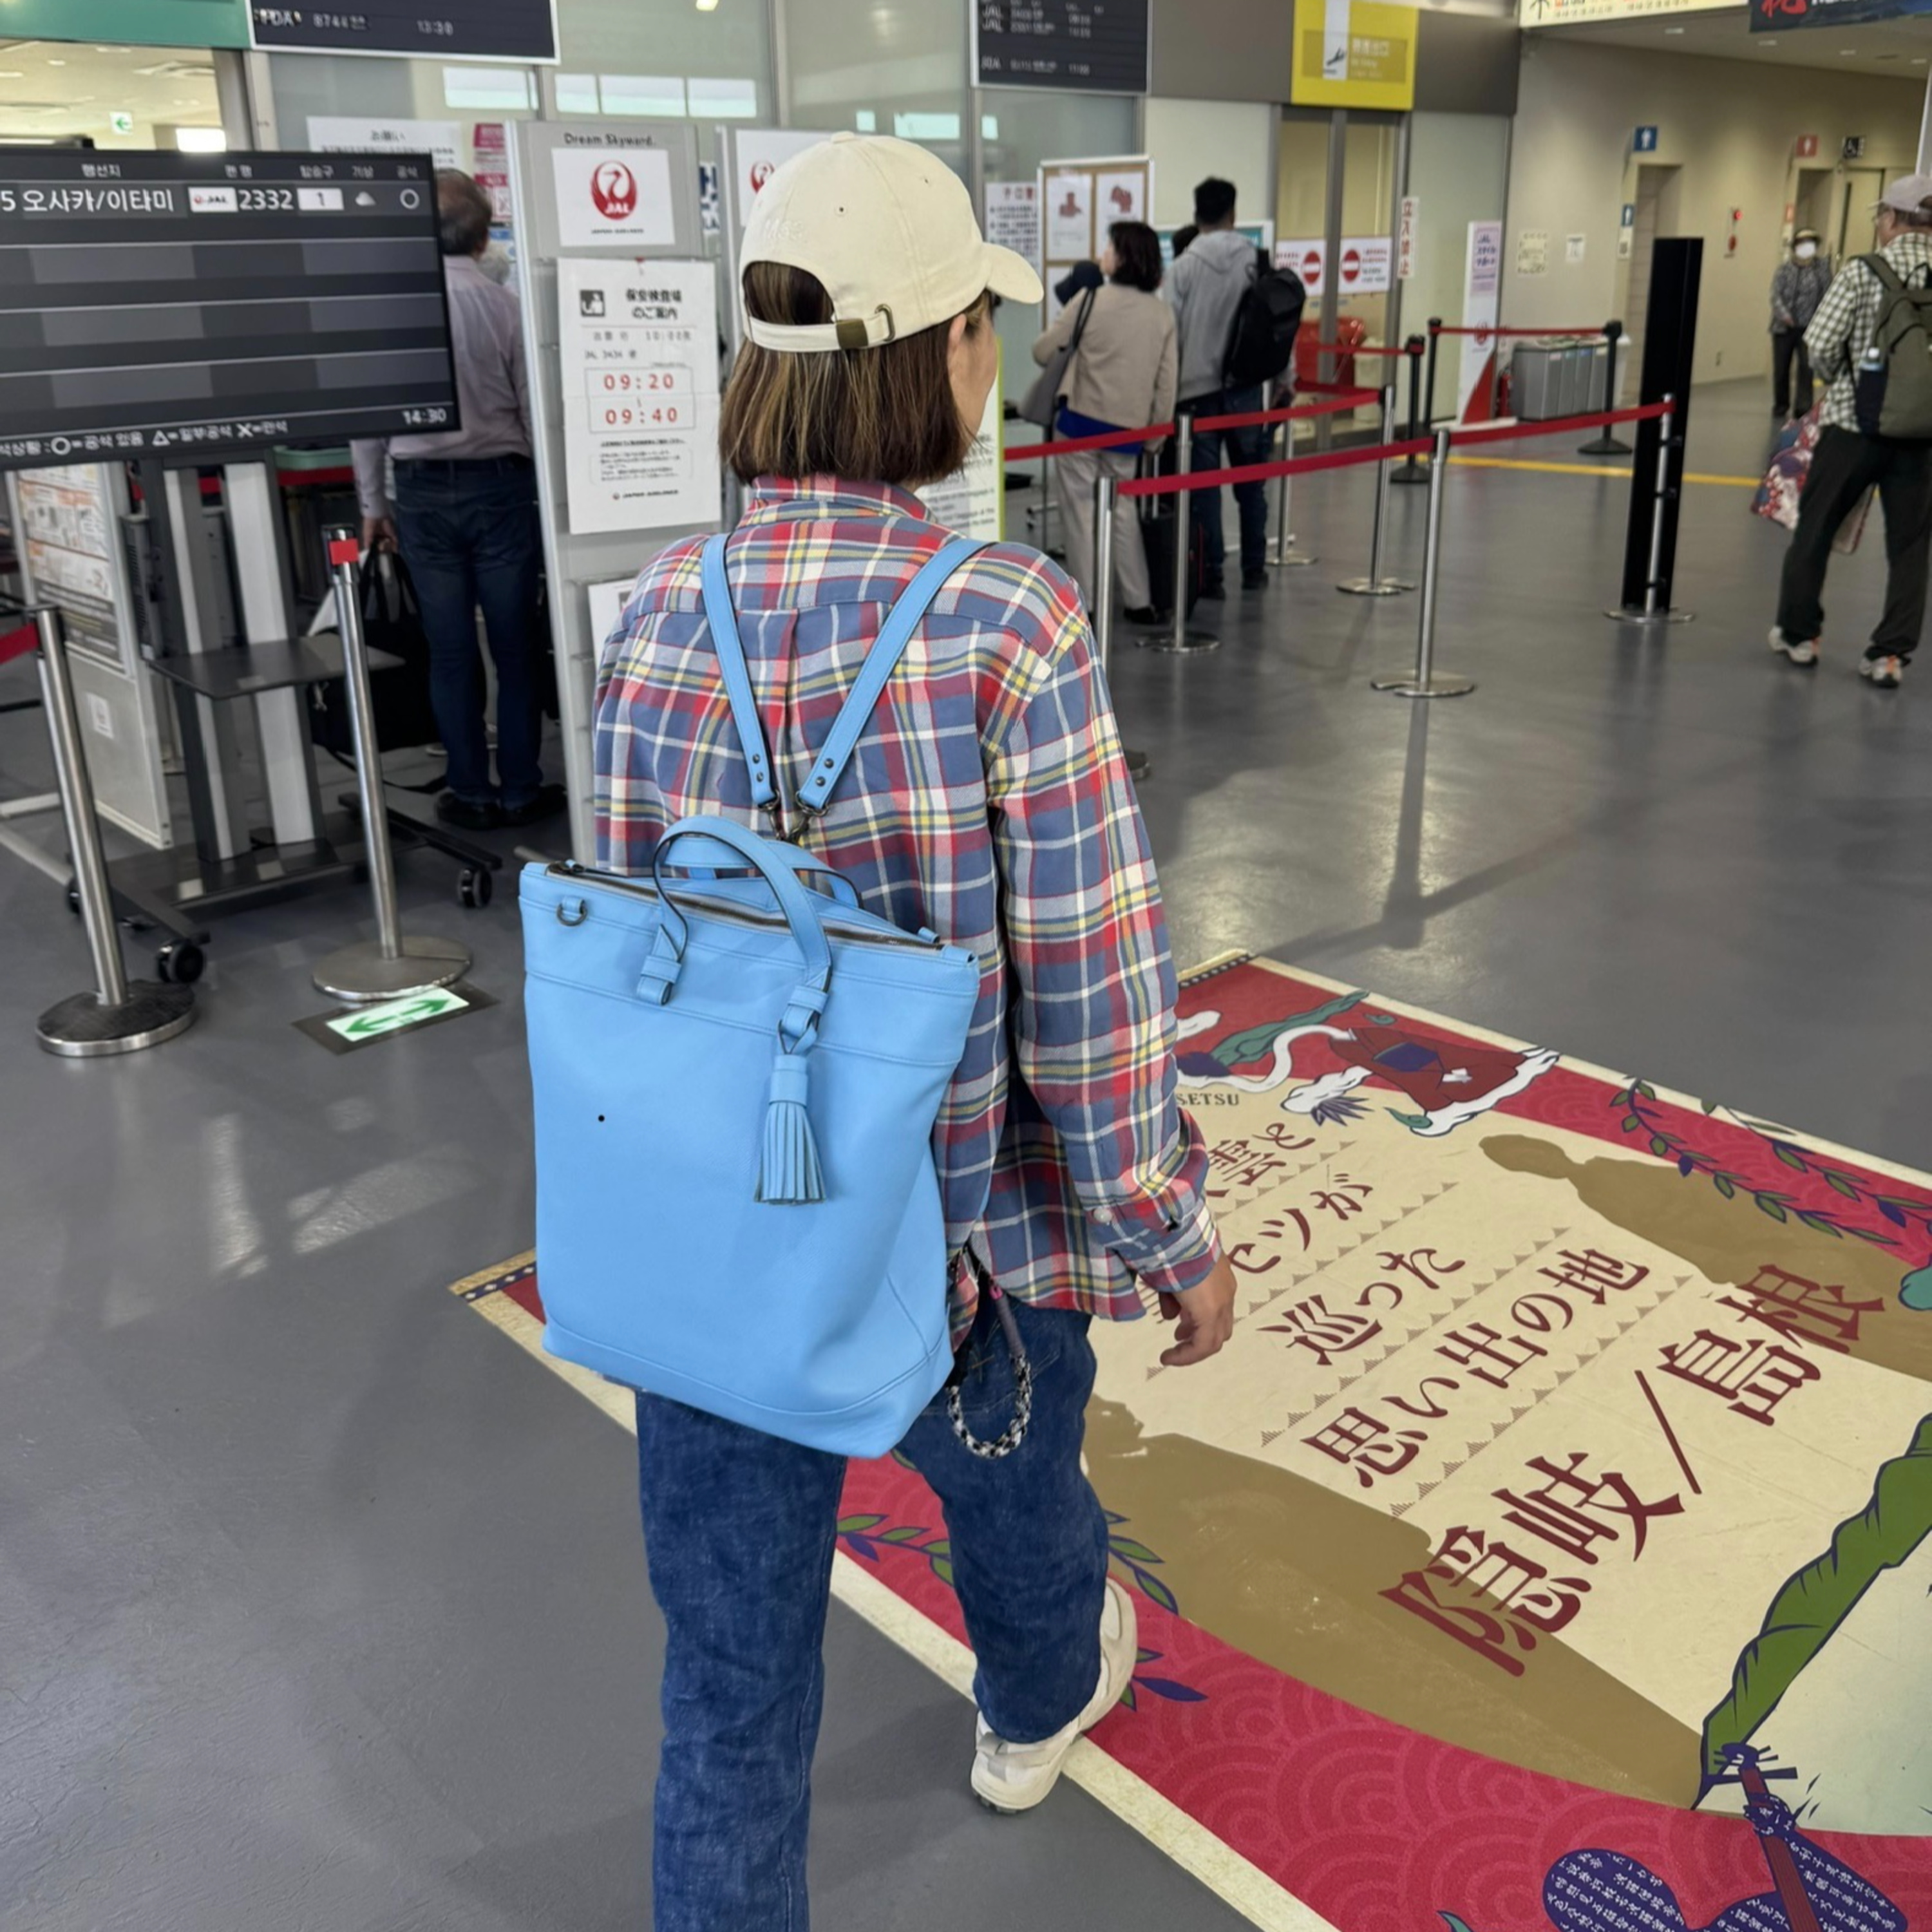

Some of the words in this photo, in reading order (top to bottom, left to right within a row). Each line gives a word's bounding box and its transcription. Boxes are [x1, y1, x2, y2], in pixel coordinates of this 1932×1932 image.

[564, 132, 602, 146] Dream
[23, 188, 175, 213] 오사카/이타미
[238, 189, 294, 211] 2332
[316, 191, 326, 207] 1
[605, 202, 630, 214] JAL
[603, 373, 674, 391] 09:20
[402, 408, 448, 426] 14:30
[605, 407, 678, 425] 09:40
[1177, 1092, 1239, 1106] SETSU
[1256, 1248, 1466, 1365] 巡った
[1300, 1248, 1650, 1488] 思い出の地
